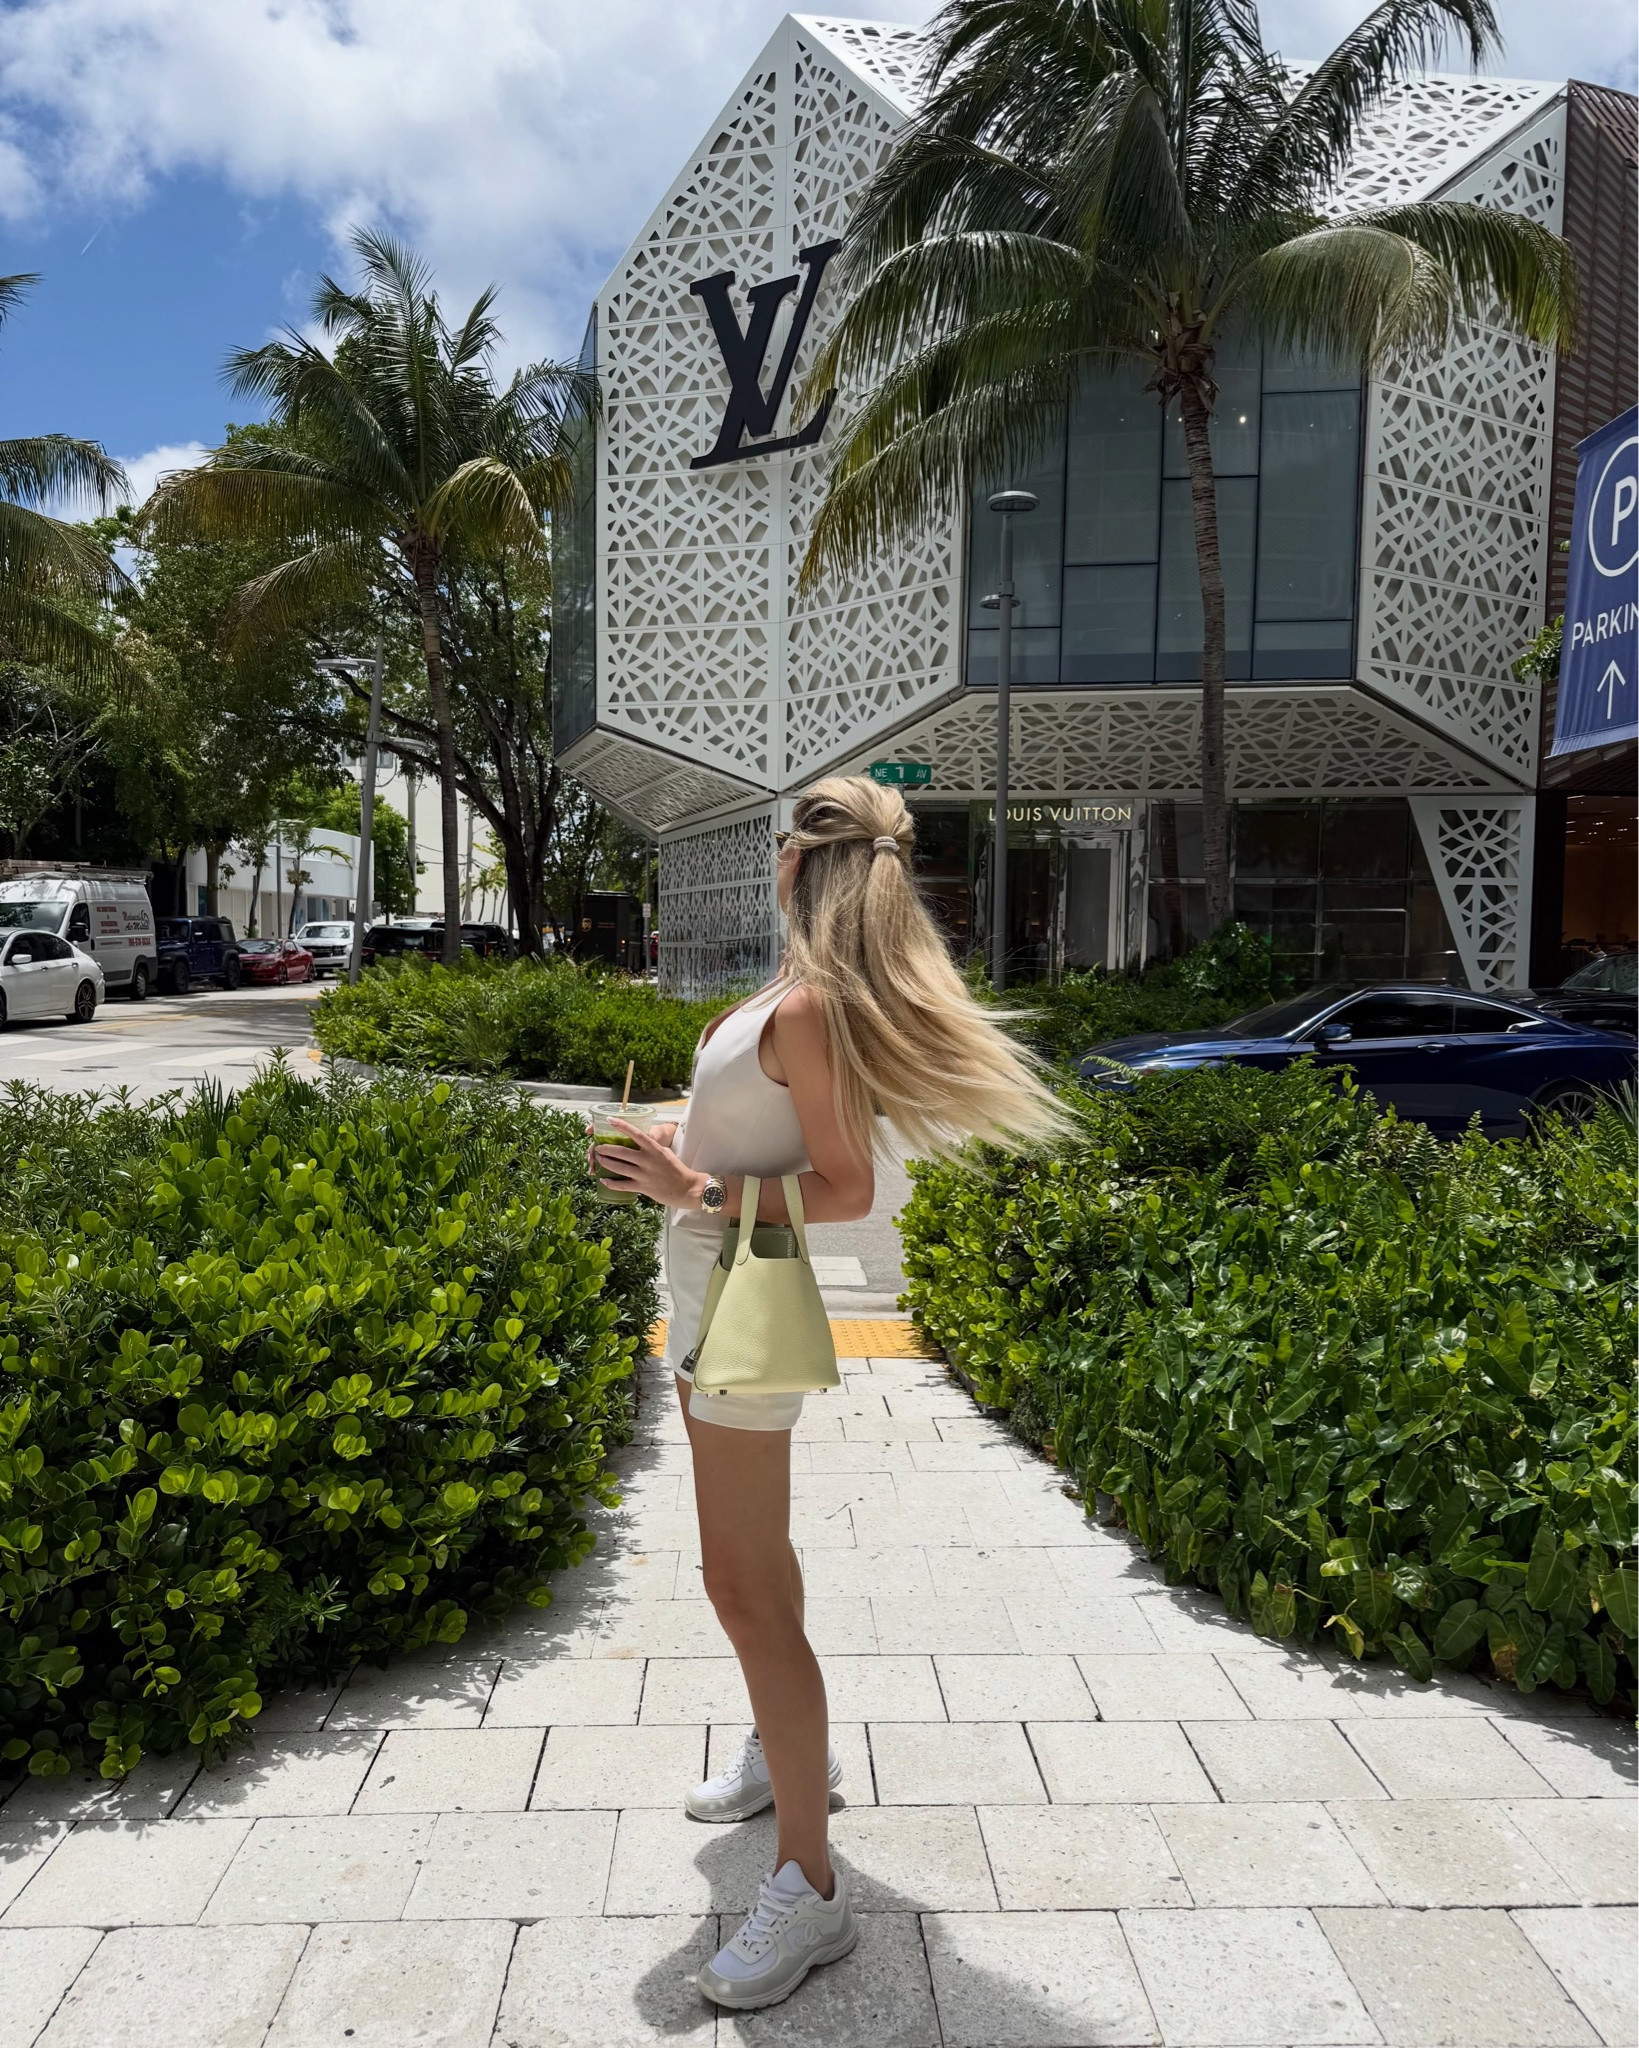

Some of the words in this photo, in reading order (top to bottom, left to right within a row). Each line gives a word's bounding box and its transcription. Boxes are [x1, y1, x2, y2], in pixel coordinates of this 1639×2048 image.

[1611, 475, 1638, 547] P
[875, 768, 888, 778] NE
[895, 765, 904, 779] 1
[916, 769, 927, 779] AV
[988, 807, 1042, 822] LUIS
[1049, 807, 1132, 822] VUITTON
